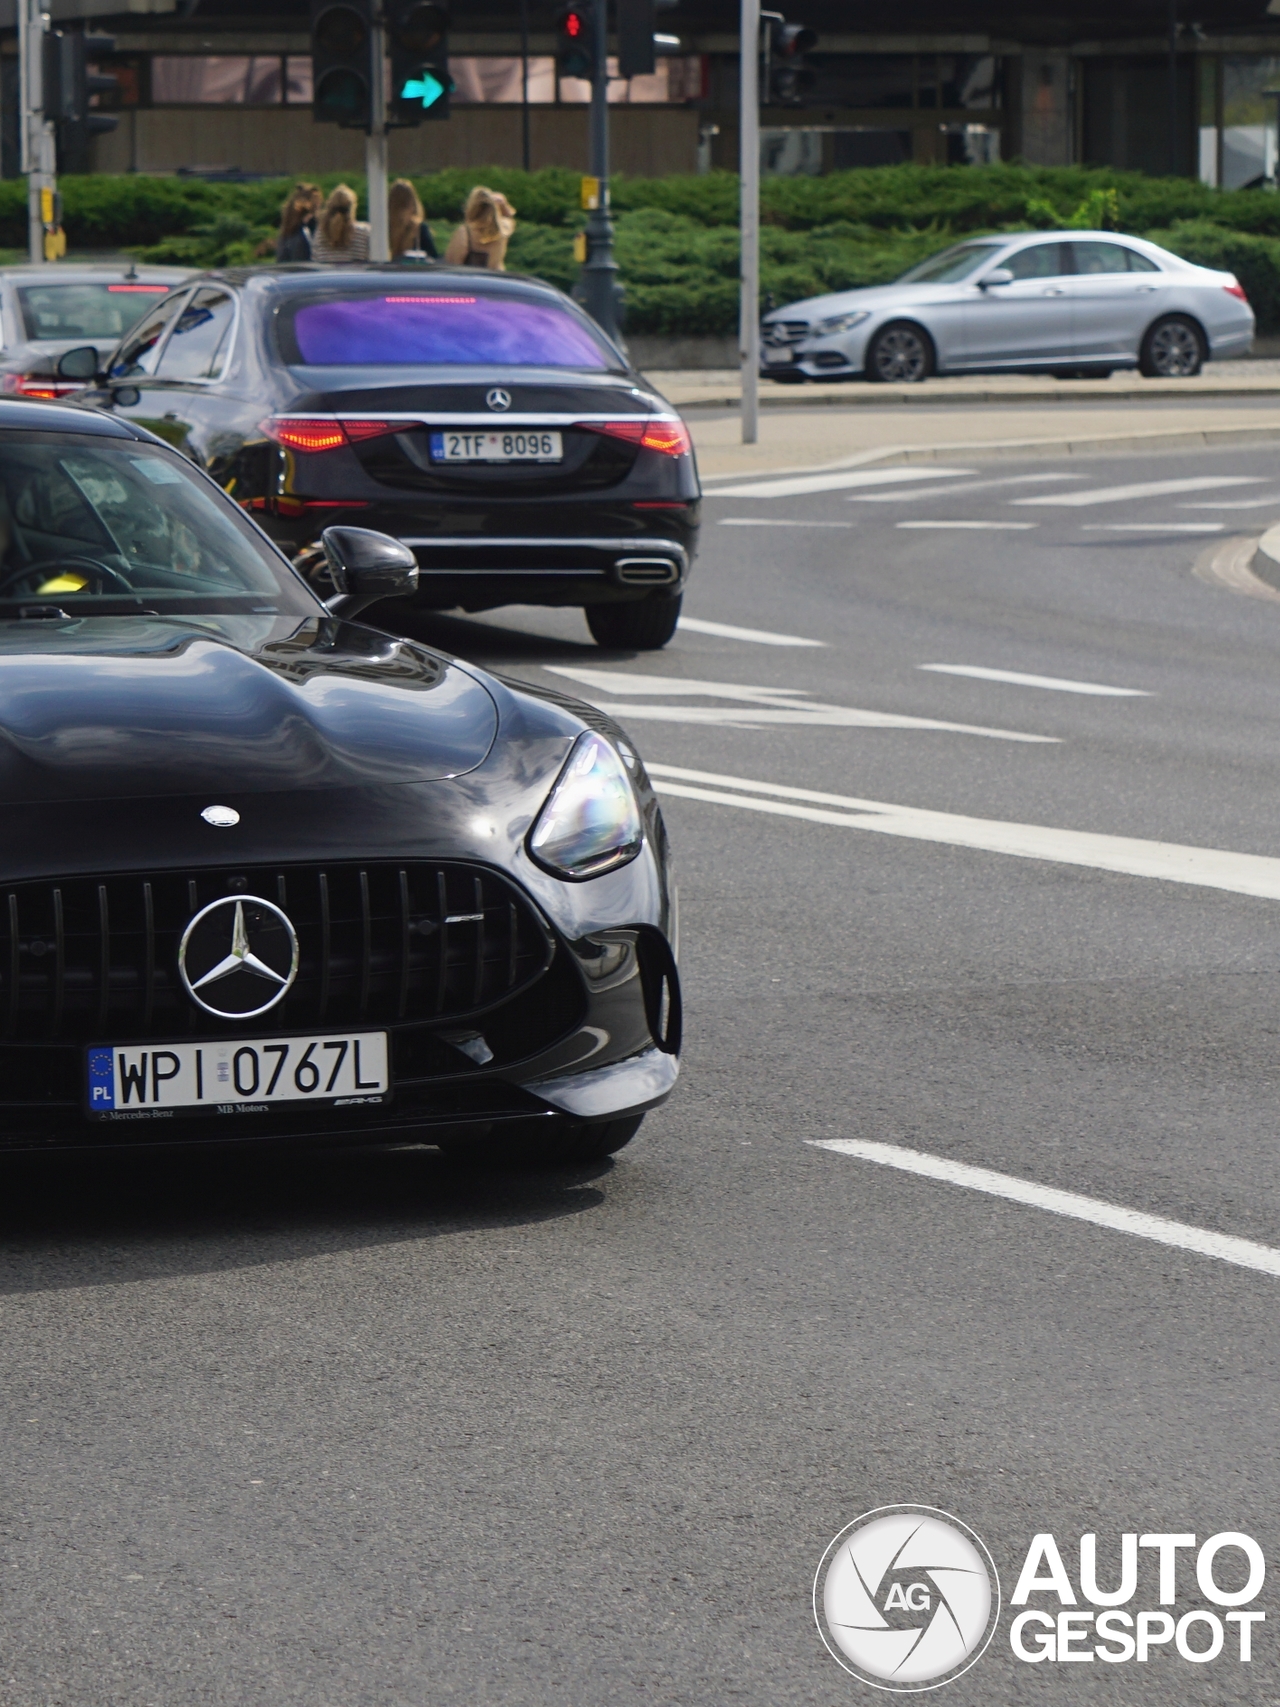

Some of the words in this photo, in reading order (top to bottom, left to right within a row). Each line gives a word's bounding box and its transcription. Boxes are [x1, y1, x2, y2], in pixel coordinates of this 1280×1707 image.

[448, 435, 485, 456] 2TF
[502, 435, 552, 455] 8096
[118, 1048, 203, 1104] WPI
[233, 1039, 380, 1097] 0767L
[93, 1087, 111, 1100] PL
[346, 1096, 383, 1105] AMG
[217, 1105, 234, 1114] MB
[236, 1103, 269, 1113] Motors
[109, 1110, 174, 1120] Mercedes-Benz
